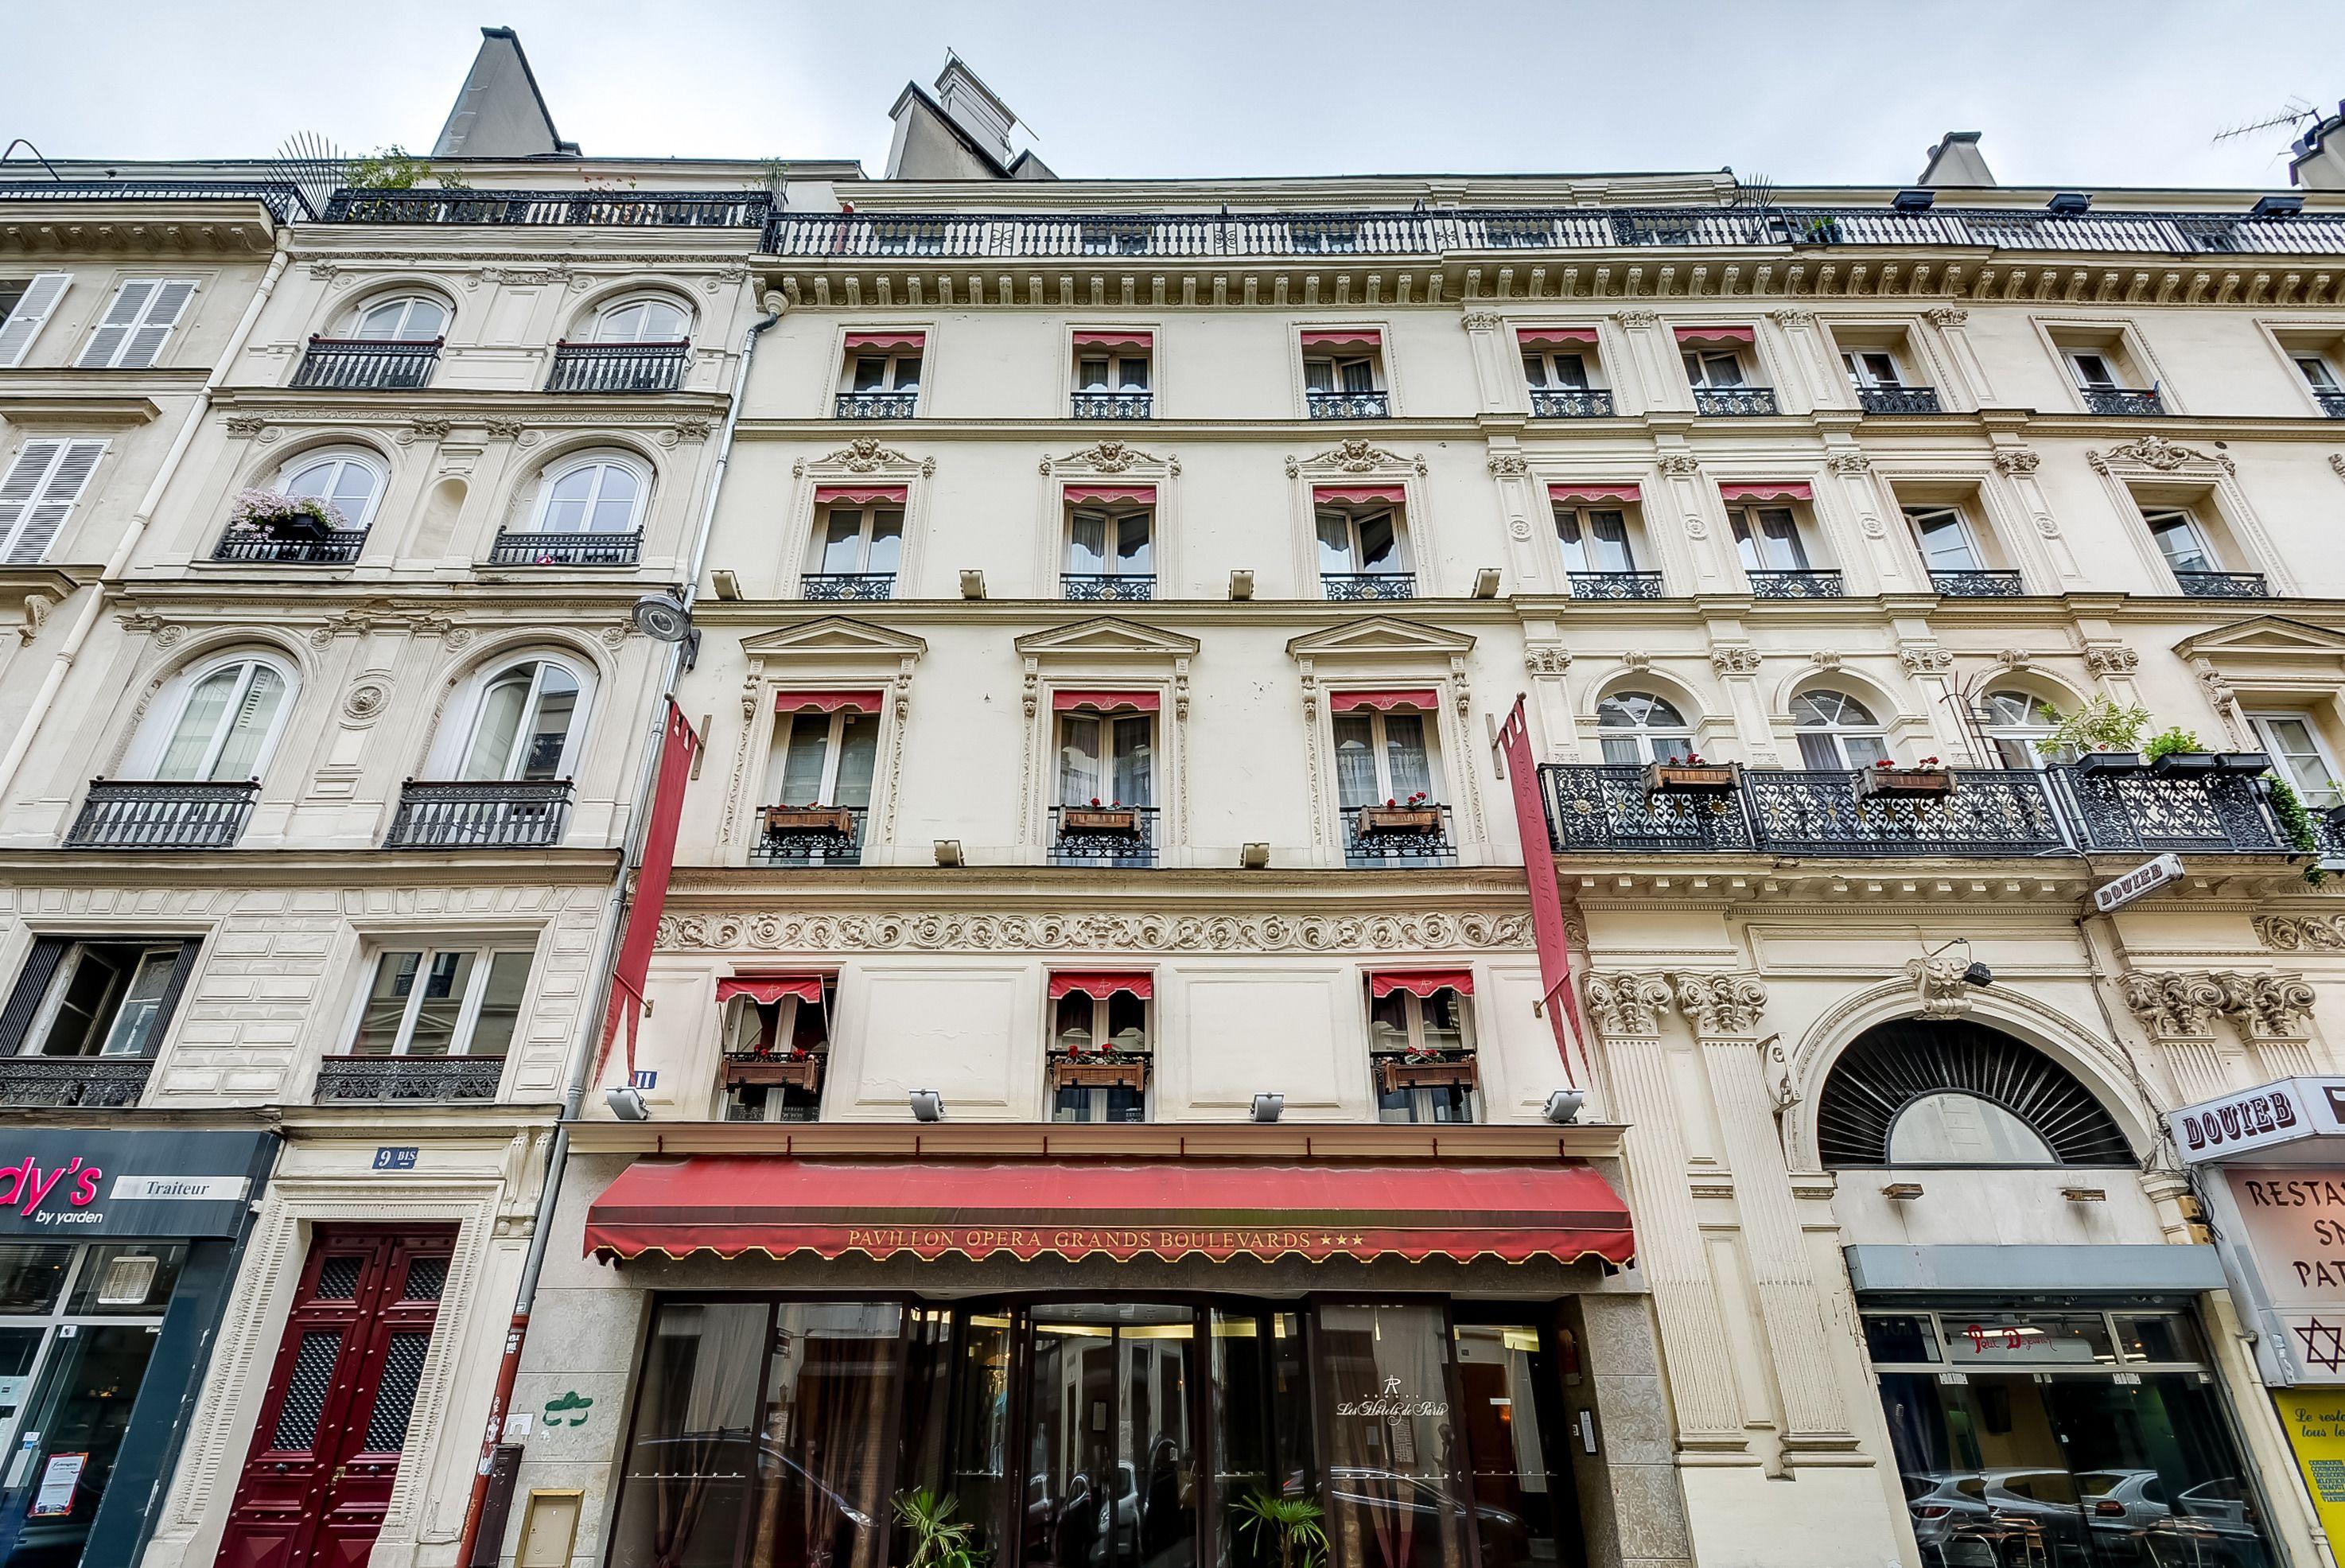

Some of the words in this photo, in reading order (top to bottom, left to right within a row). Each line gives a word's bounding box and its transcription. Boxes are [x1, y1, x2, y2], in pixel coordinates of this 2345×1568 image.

[2100, 864, 2162, 905] DOUIEB
[636, 1072, 651, 1088] 11
[2183, 1090, 2297, 1151] DOUIEB
[378, 1150, 391, 1167] 9
[146, 1180, 210, 1196] Traiteur
[2245, 1181, 2345, 1207] RESTA
[35, 1210, 53, 1225] by
[55, 1210, 103, 1226] yarden
[848, 1230, 955, 1247] PAVILLON
[966, 1231, 1042, 1247] OPERA
[1054, 1231, 1151, 1247] GRANDS
[1160, 1231, 1311, 1248] BOULEVARDS
[1336, 1402, 1358, 1416] Les
[1402, 1403, 1413, 1416] de
[1413, 1400, 1449, 1416] Paris
[2295, 1407, 2314, 1422] Le
